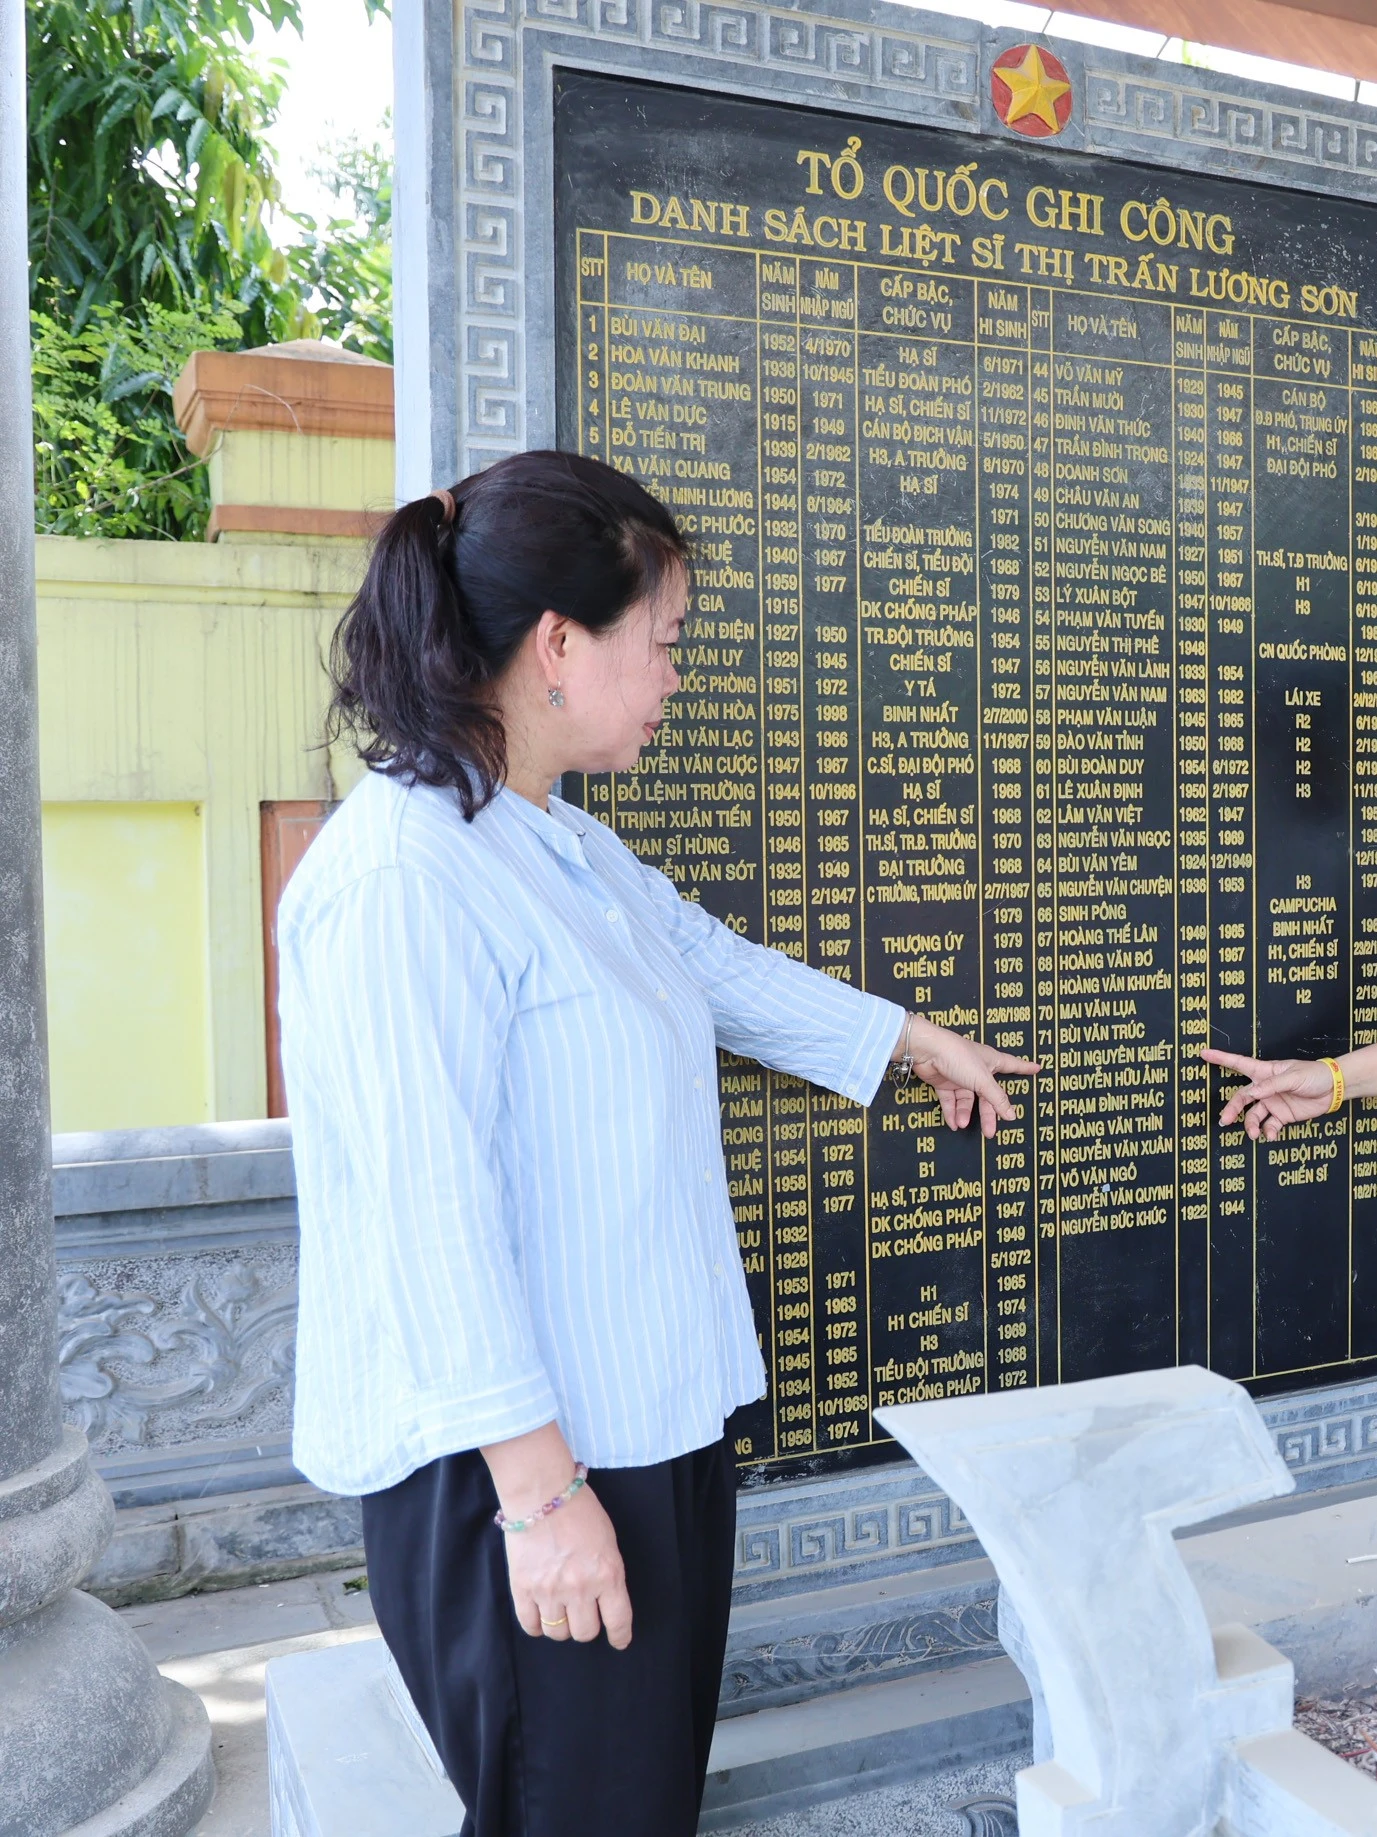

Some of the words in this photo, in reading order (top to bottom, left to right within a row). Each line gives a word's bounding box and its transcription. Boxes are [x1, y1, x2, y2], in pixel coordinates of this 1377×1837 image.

[796, 135, 865, 200] TỔ
[882, 161, 1009, 221] QUỐC
[1025, 185, 1105, 236] GHI
[1119, 196, 1236, 255] CÔNG
[629, 190, 750, 237] DANH
[763, 205, 867, 252] SÁCH
[879, 223, 961, 267] LIỆT
[971, 232, 1006, 270] SĨ
[1013, 242, 1075, 285] THỊ
[1084, 252, 1179, 293] TRẤN
[1189, 267, 1291, 309] LƯƠNG
[1300, 284, 1359, 318] SƠN
[579, 256, 604, 276] STT
[626, 262, 652, 284] HỌ
[654, 262, 678, 286] VÀ
[679, 264, 712, 289] TÊN
[761, 261, 795, 285] NĂM
[814, 266, 839, 290] NĂM
[880, 273, 914, 298] CẤP
[916, 279, 953, 305] BẬC,
[987, 289, 1018, 310] NĂM
[762, 291, 797, 313] SINH
[799, 294, 830, 317] NHẬP
[830, 298, 854, 319] NGŨ
[589, 314, 596, 333] 1
[881, 305, 927, 327] CHỨC
[932, 312, 952, 332] VỤ
[978, 318, 993, 335] HI
[995, 318, 1027, 338] SINH
[1030, 309, 1050, 326] STT
[1067, 315, 1088, 334] HỌ
[1091, 317, 1107, 332] VÀ
[1111, 317, 1137, 337] TÊN
[1175, 313, 1204, 335] NĂM
[610, 314, 638, 336] BÙI
[641, 317, 675, 339] VĂN
[678, 323, 706, 343] ĐẠI
[1218, 319, 1239, 339] NĂM
[1274, 324, 1300, 345] CẤP
[1302, 329, 1333, 351] BẬC,
[764, 334, 796, 352] 1952
[1175, 340, 1203, 360] SINH
[898, 347, 919, 366] HẠ
[922, 345, 938, 366] SĨ
[1206, 343, 1231, 362] NHẬP
[1231, 346, 1251, 365] NGŨ
[803, 363, 855, 384] 10/1945
[1077, 364, 1102, 383] VĂN
[1104, 367, 1124, 385] MỸ
[1273, 352, 1311, 374] CHỨC
[1313, 358, 1331, 378] VỤ
[1351, 362, 1365, 380] HI
[862, 363, 896, 388] TIỂU
[897, 371, 939, 391] ĐOÀN
[941, 375, 972, 395] PHÓ
[1177, 377, 1204, 395] 1929
[1054, 384, 1090, 406] TRẦN
[1091, 391, 1124, 410] MƯỜI
[1217, 382, 1244, 400] 1945
[1282, 389, 1307, 405] CÁN
[1309, 390, 1327, 409] BỘ
[983, 406, 1027, 426] 11/1972
[1258, 642, 1275, 658] CN
[1275, 639, 1308, 660] QUỐC
[1309, 644, 1347, 662] PHÒNG
[904, 679, 915, 695] Y
[916, 677, 937, 697] TÁ
[1285, 688, 1304, 706] LÁI
[1304, 690, 1321, 706] XE
[816, 704, 848, 722] 1998
[882, 705, 917, 723] BINH
[919, 702, 959, 723] NHẤT
[983, 706, 1029, 724] 2/7/2000
[1056, 754, 1079, 775] BÙI
[1080, 755, 1117, 775] ĐOÀN
[1118, 758, 1144, 775] DUY
[617, 778, 642, 801] ĐỖ
[644, 780, 687, 804] LỆNH
[691, 779, 756, 801] TRƯỜNG
[1058, 905, 1089, 922] SINH
[1091, 900, 1127, 920] PÔNG
[1269, 896, 1337, 914] CAMPUCHIA
[1268, 1149, 1289, 1165] ĐẠI
[1289, 1144, 1311, 1165] ĐỘI
[1313, 1141, 1338, 1160] PHÓ
[1279, 1162, 1314, 1186] CHIẾN
[1315, 1164, 1328, 1182] SĨ
[996, 1200, 1025, 1219] 1947
[1181, 1203, 1207, 1220] 1922
[1220, 1199, 1245, 1216] 1944
[1060, 1210, 1108, 1236] NGUYỄN
[1109, 1210, 1135, 1230] ĐỨC
[1135, 1206, 1167, 1226] KHÚC
[826, 1270, 856, 1289] 1971
[887, 1313, 905, 1331] H1
[908, 1303, 952, 1328] CHIẾN
[954, 1301, 969, 1322] SĨ
[777, 1327, 810, 1346] 1954
[875, 1359, 904, 1382] TIỂU
[905, 1357, 929, 1379] ĐỘI
[931, 1350, 984, 1373] TRƯỞNG
[826, 1370, 858, 1389] 1952
[827, 1420, 859, 1439] 1974
